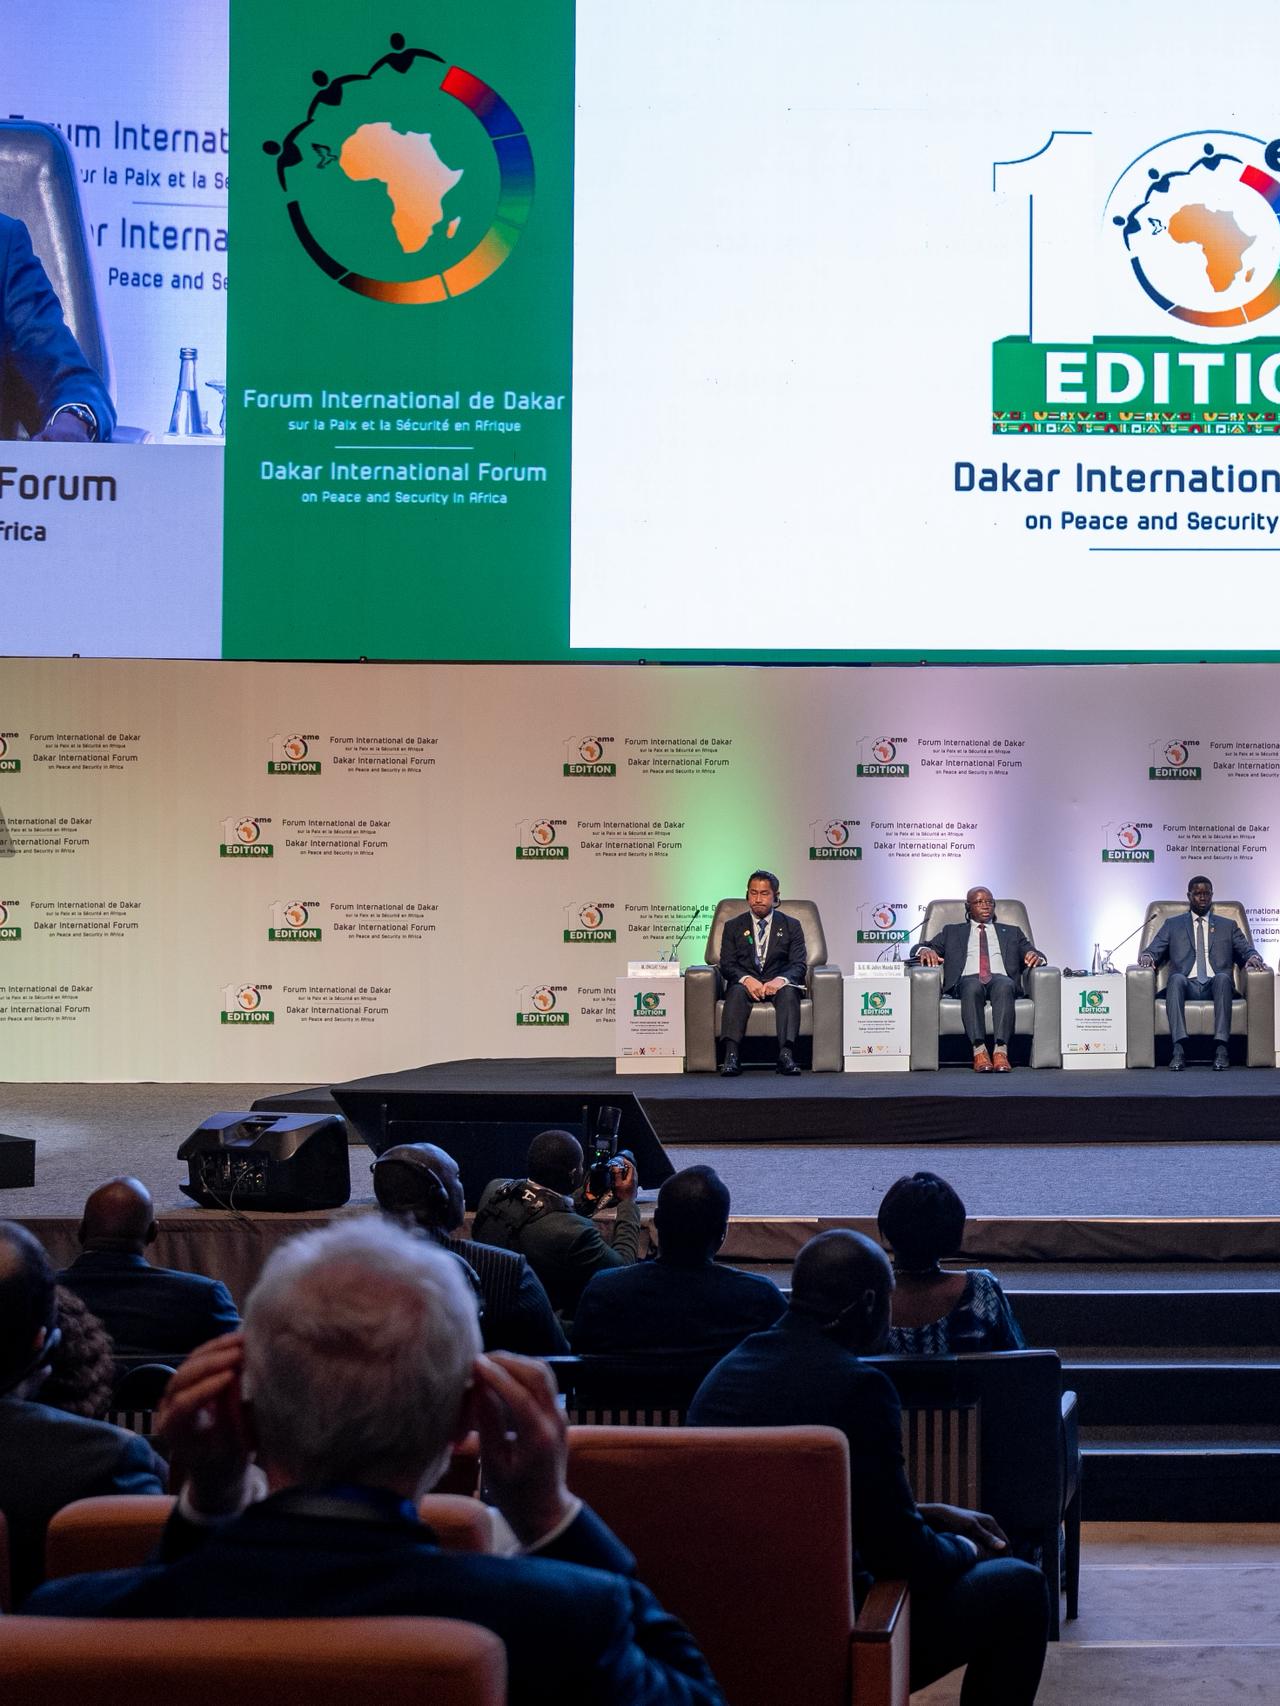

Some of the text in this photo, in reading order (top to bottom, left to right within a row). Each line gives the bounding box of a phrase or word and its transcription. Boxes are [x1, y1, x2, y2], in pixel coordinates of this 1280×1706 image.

[104, 167, 118, 184] la
[125, 168, 161, 187] Paix
[168, 172, 185, 188] et
[193, 171, 206, 189] la
[109, 267, 163, 288] Peace
[171, 271, 204, 290] and
[244, 389, 565, 410] Forum International de Dakar
[288, 418, 521, 434] sur la Paix et la Sécurité en Afrique
[261, 461, 547, 482] Dakar International Forum
[954, 461, 1061, 492] Dakar
[0, 466, 117, 502] Forum
[302, 490, 508, 505] on Peace and Security in Africa
[1025, 515, 1052, 530] on
[1061, 511, 1128, 530] Peace
[1137, 511, 1178, 530] and
[1187, 511, 1279, 534] Security
[330, 736, 438, 745] Forum International de Dakar
[918, 738, 941, 746] Forum
[944, 739, 990, 747] International
[1004, 739, 1025, 747] Dakar
[274, 763, 316, 771] EDITION
[333, 756, 435, 765] Dakar International Forum
[921, 758, 943, 767] Dakar
[945, 759, 995, 767] International
[863, 766, 904, 774] EDITION
[1163, 824, 1186, 832] Forum
[1249, 824, 1270, 832] Dakar
[1166, 844, 1188, 852] Dakar
[1242, 844, 1267, 852] Forum
